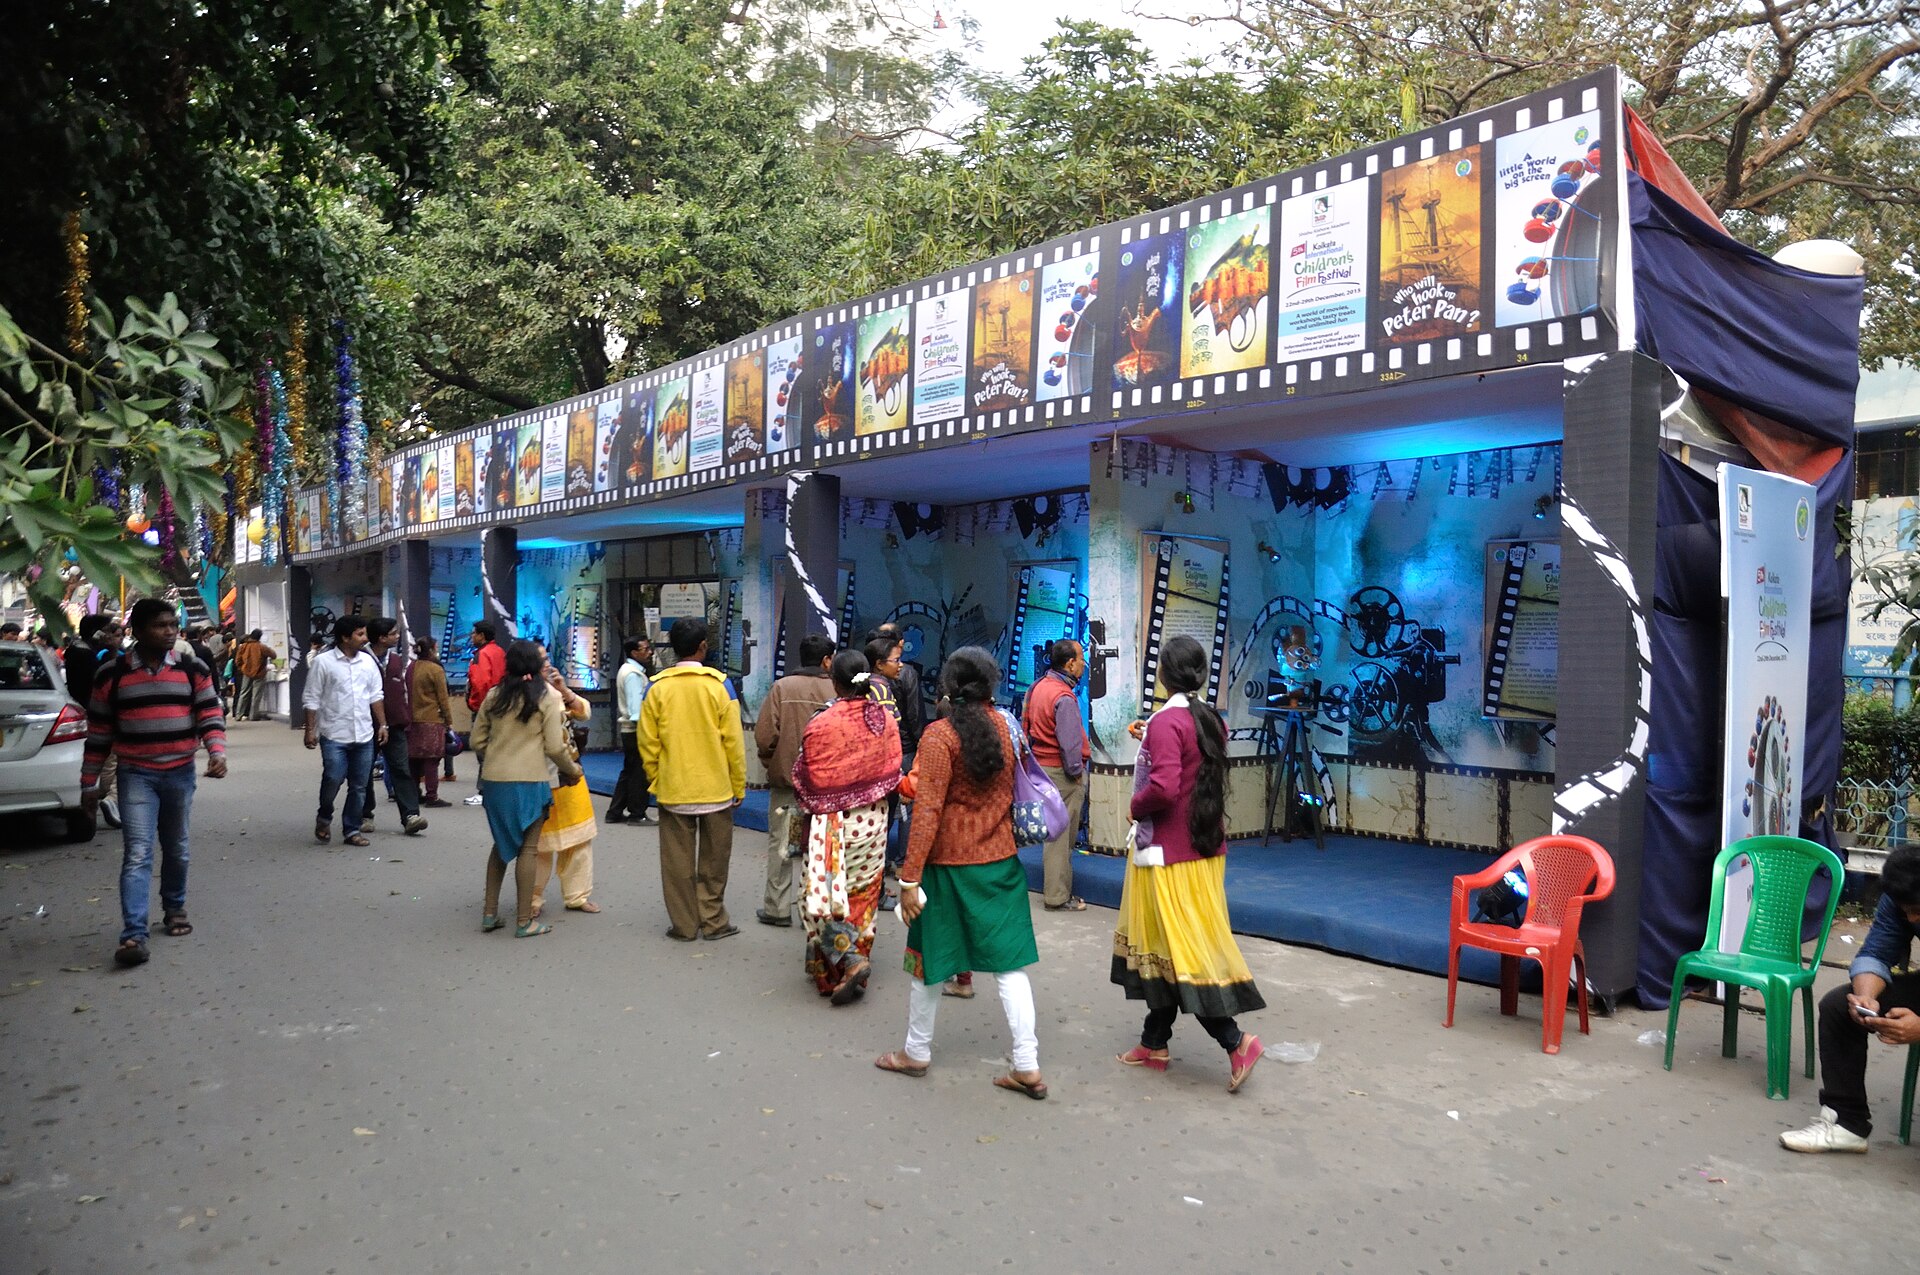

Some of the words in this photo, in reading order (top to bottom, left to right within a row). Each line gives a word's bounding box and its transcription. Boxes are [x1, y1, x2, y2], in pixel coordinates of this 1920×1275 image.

[1523, 152, 1533, 161] A
[1499, 163, 1524, 178] little
[1526, 156, 1557, 167] world
[1512, 170, 1524, 179] on
[1528, 166, 1543, 174] the
[1504, 180, 1519, 190] big
[1521, 173, 1551, 183] screen
[1313, 241, 1336, 250] Kolkata
[1294, 251, 1354, 275] Children's
[1296, 275, 1317, 288] Film
[1317, 266, 1352, 284] Festival
[1414, 275, 1435, 290] will
[1411, 282, 1445, 306] hook
[1444, 290, 1456, 300] up
[1382, 304, 1431, 337] Peter
[1516, 353, 1527, 363] 34
[974, 383, 1002, 406] Peter
